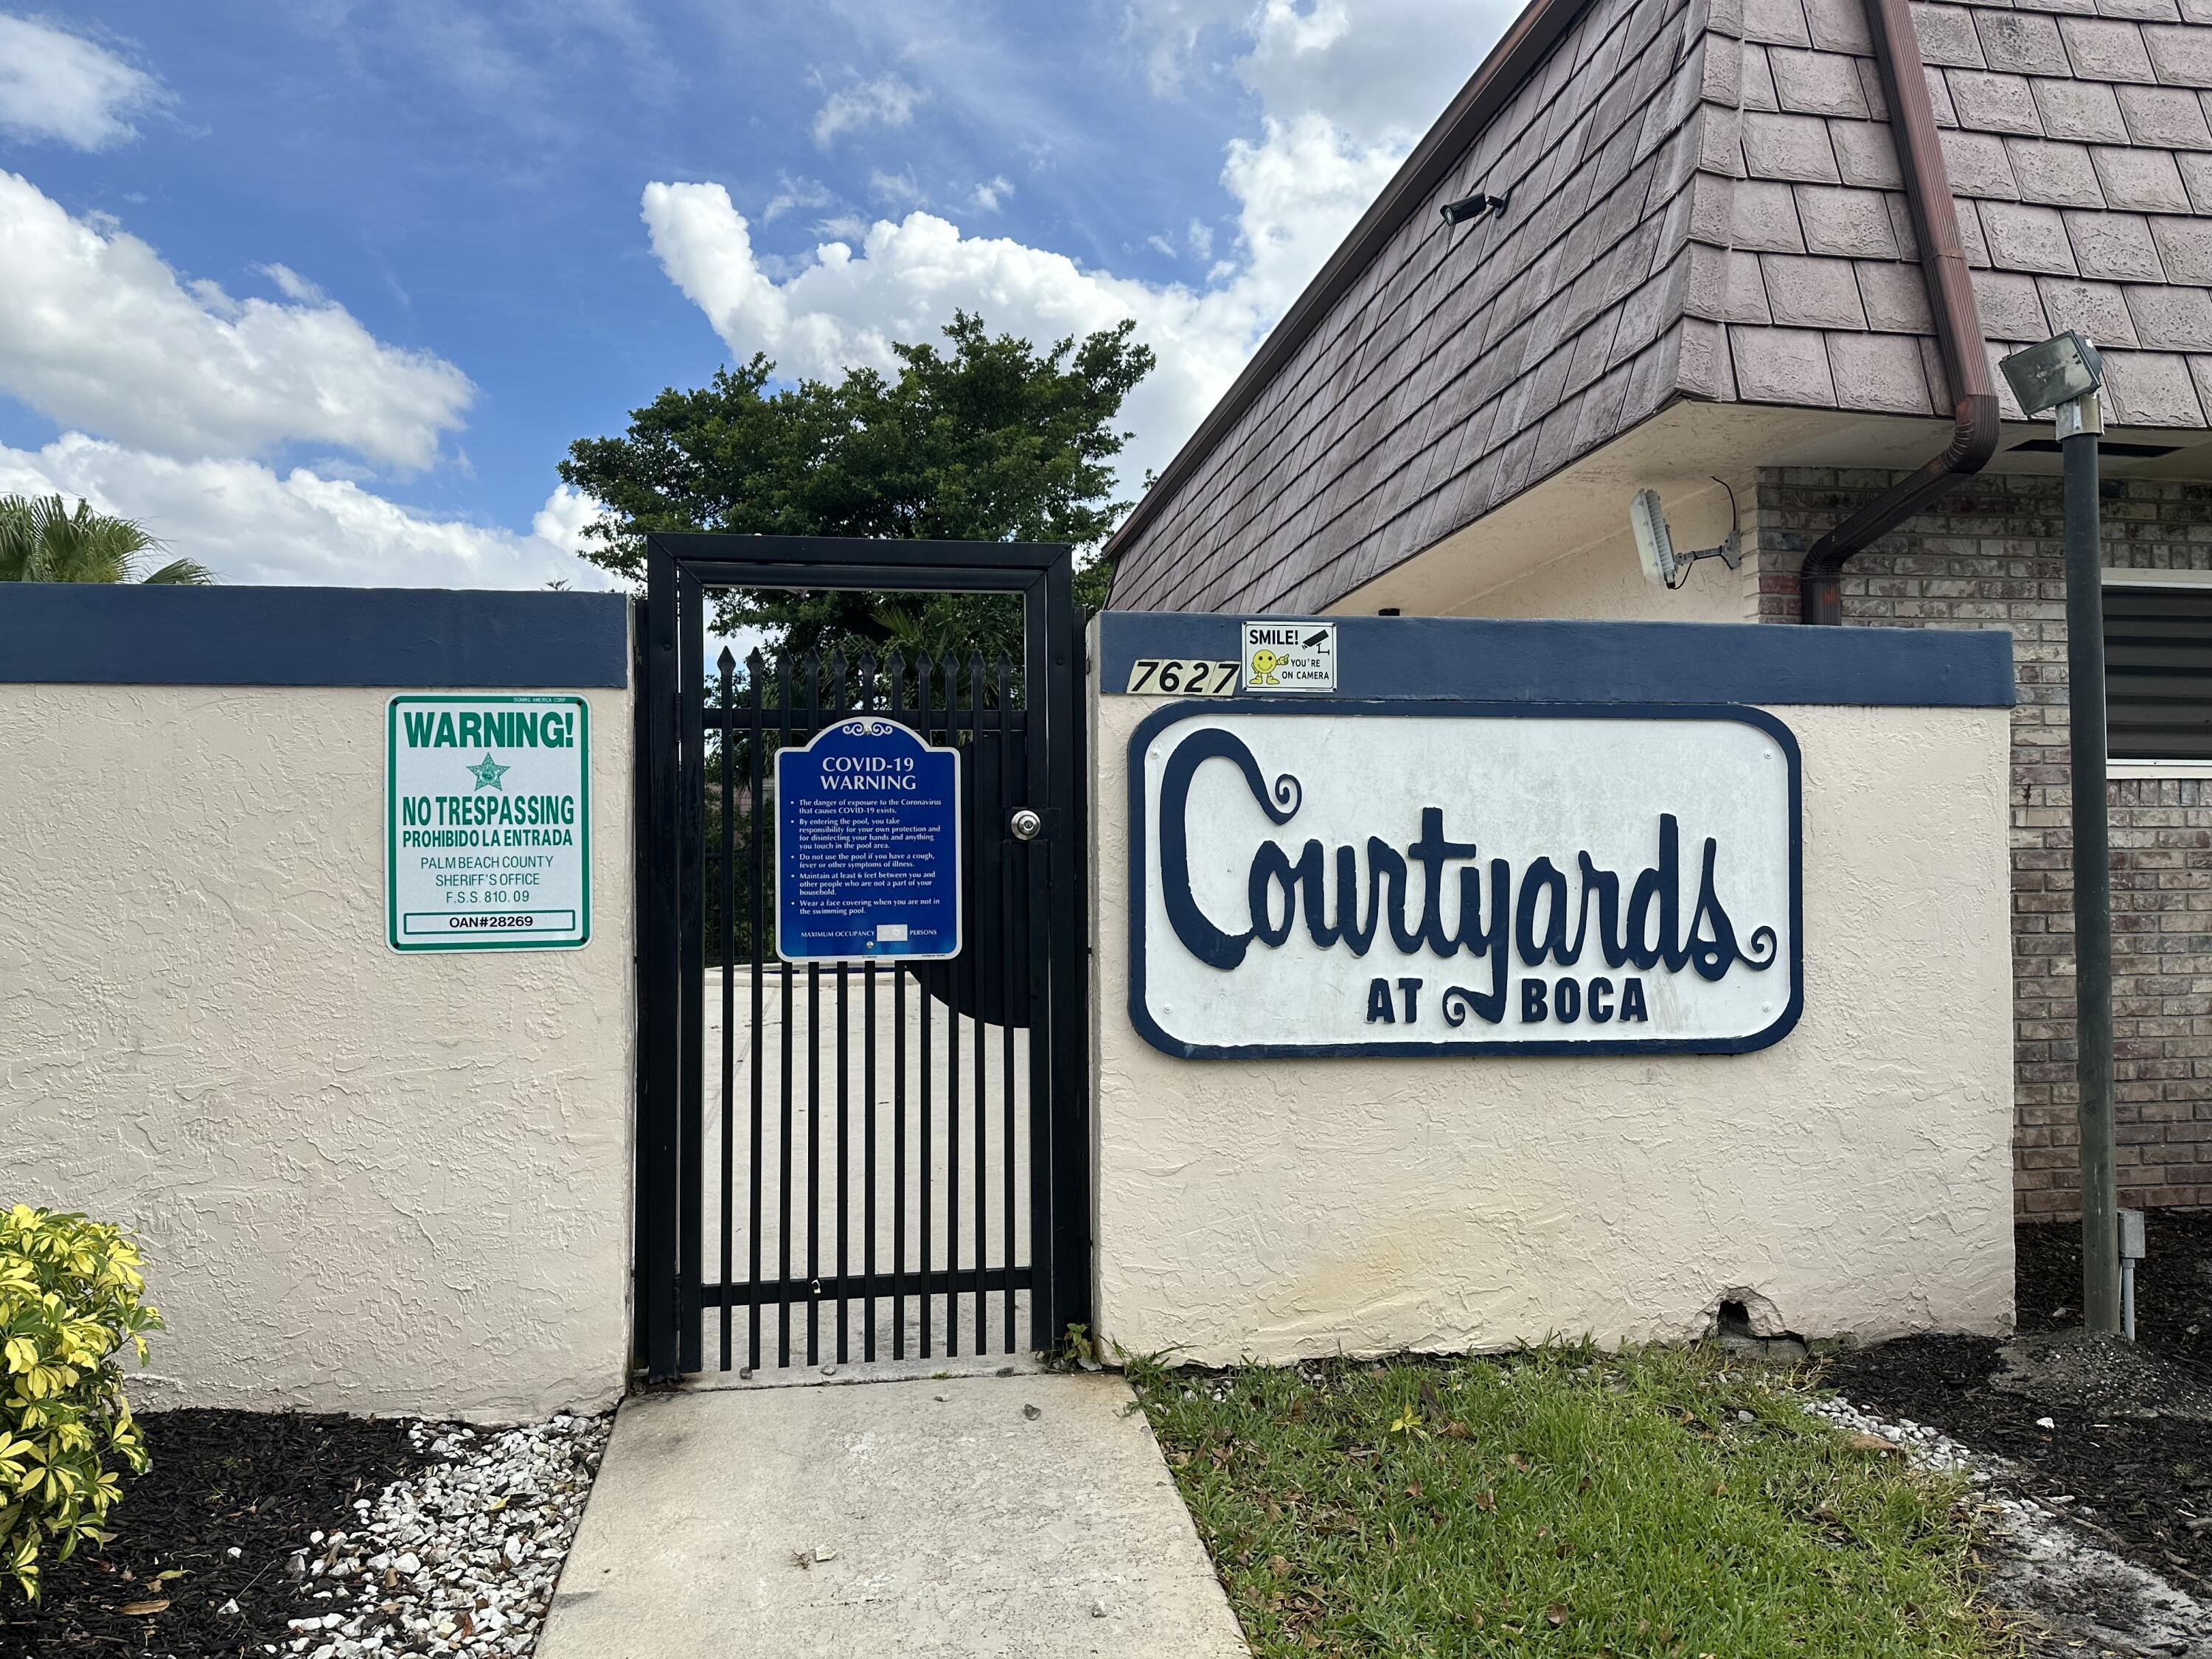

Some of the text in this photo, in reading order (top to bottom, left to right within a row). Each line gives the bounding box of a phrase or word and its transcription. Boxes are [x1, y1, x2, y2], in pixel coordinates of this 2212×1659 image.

[1250, 630, 1298, 645] SMILE!
[1291, 658, 1320, 667] YOU'RE
[1131, 661, 1239, 693] 7627
[403, 712, 574, 748] WARNING!
[822, 757, 914, 772] COVID-19
[820, 775, 916, 790] WARNING
[814, 799, 837, 807] danger
[403, 796, 574, 826] NO TRESPASSING
[810, 818, 838, 826] entering
[799, 827, 844, 835] responsibility
[892, 826, 926, 834] protection
[403, 829, 573, 847] PROHIBIDO LA ENTRADA
[857, 842, 872, 850] pool
[421, 855, 554, 869] PALM BEACH COUNTY
[852, 853, 866, 861] pool
[913, 852, 935, 860] cough,
[436, 873, 540, 886] SHERIFF'S OFFICE
[1158, 728, 1777, 1026] Courtyards
[820, 880, 842, 888] people
[446, 891, 481, 903] F.S.S.
[843, 899, 872, 907] covering
[849, 907, 866, 915] pool.
[449, 916, 533, 928] OAN#28269
[1366, 977, 1648, 1023] AT BOCA
